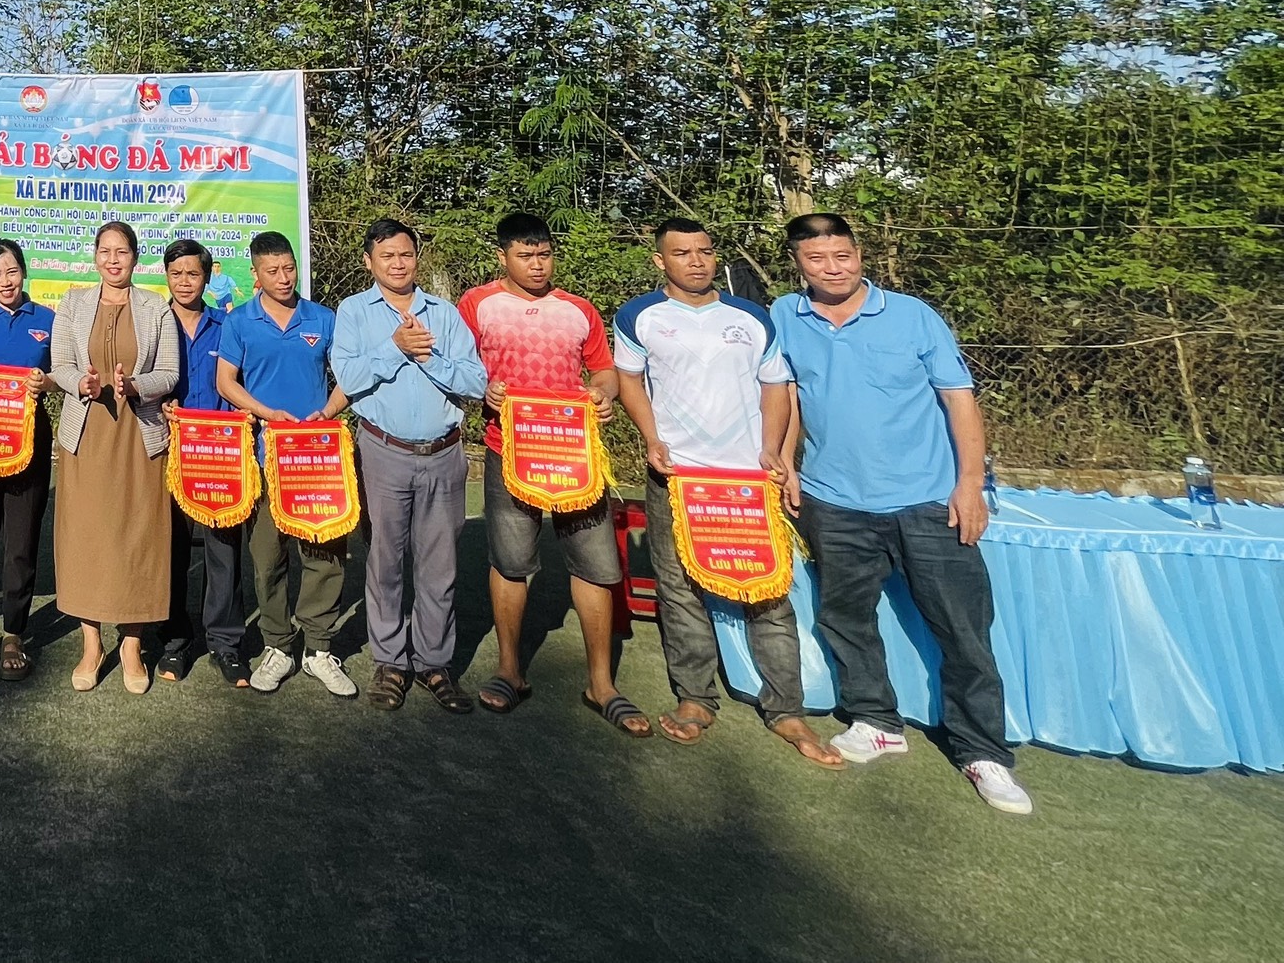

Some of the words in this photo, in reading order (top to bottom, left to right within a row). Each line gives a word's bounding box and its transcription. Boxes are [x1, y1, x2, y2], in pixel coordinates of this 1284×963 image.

[33, 134, 120, 171] BÓNG
[127, 140, 171, 171] ĐÁ
[179, 146, 251, 171] MINI
[16, 176, 34, 199] XÃ
[38, 180, 57, 200] EA
[112, 181, 144, 203] NĂM
[148, 184, 186, 205] 2024
[184, 214, 203, 223] NAM
[222, 215, 234, 224] EA
[44, 225, 64, 235] LHTN
[221, 231, 241, 240] 2024
[527, 471, 547, 483] Lưu
[550, 473, 578, 487] Niệm
[192, 490, 208, 501] Lưu
[211, 491, 233, 505] Niệm
[292, 503, 309, 513] Lưu
[313, 503, 338, 516] Niệm
[708, 557, 731, 569] Lưu
[734, 558, 765, 573] Niệm
